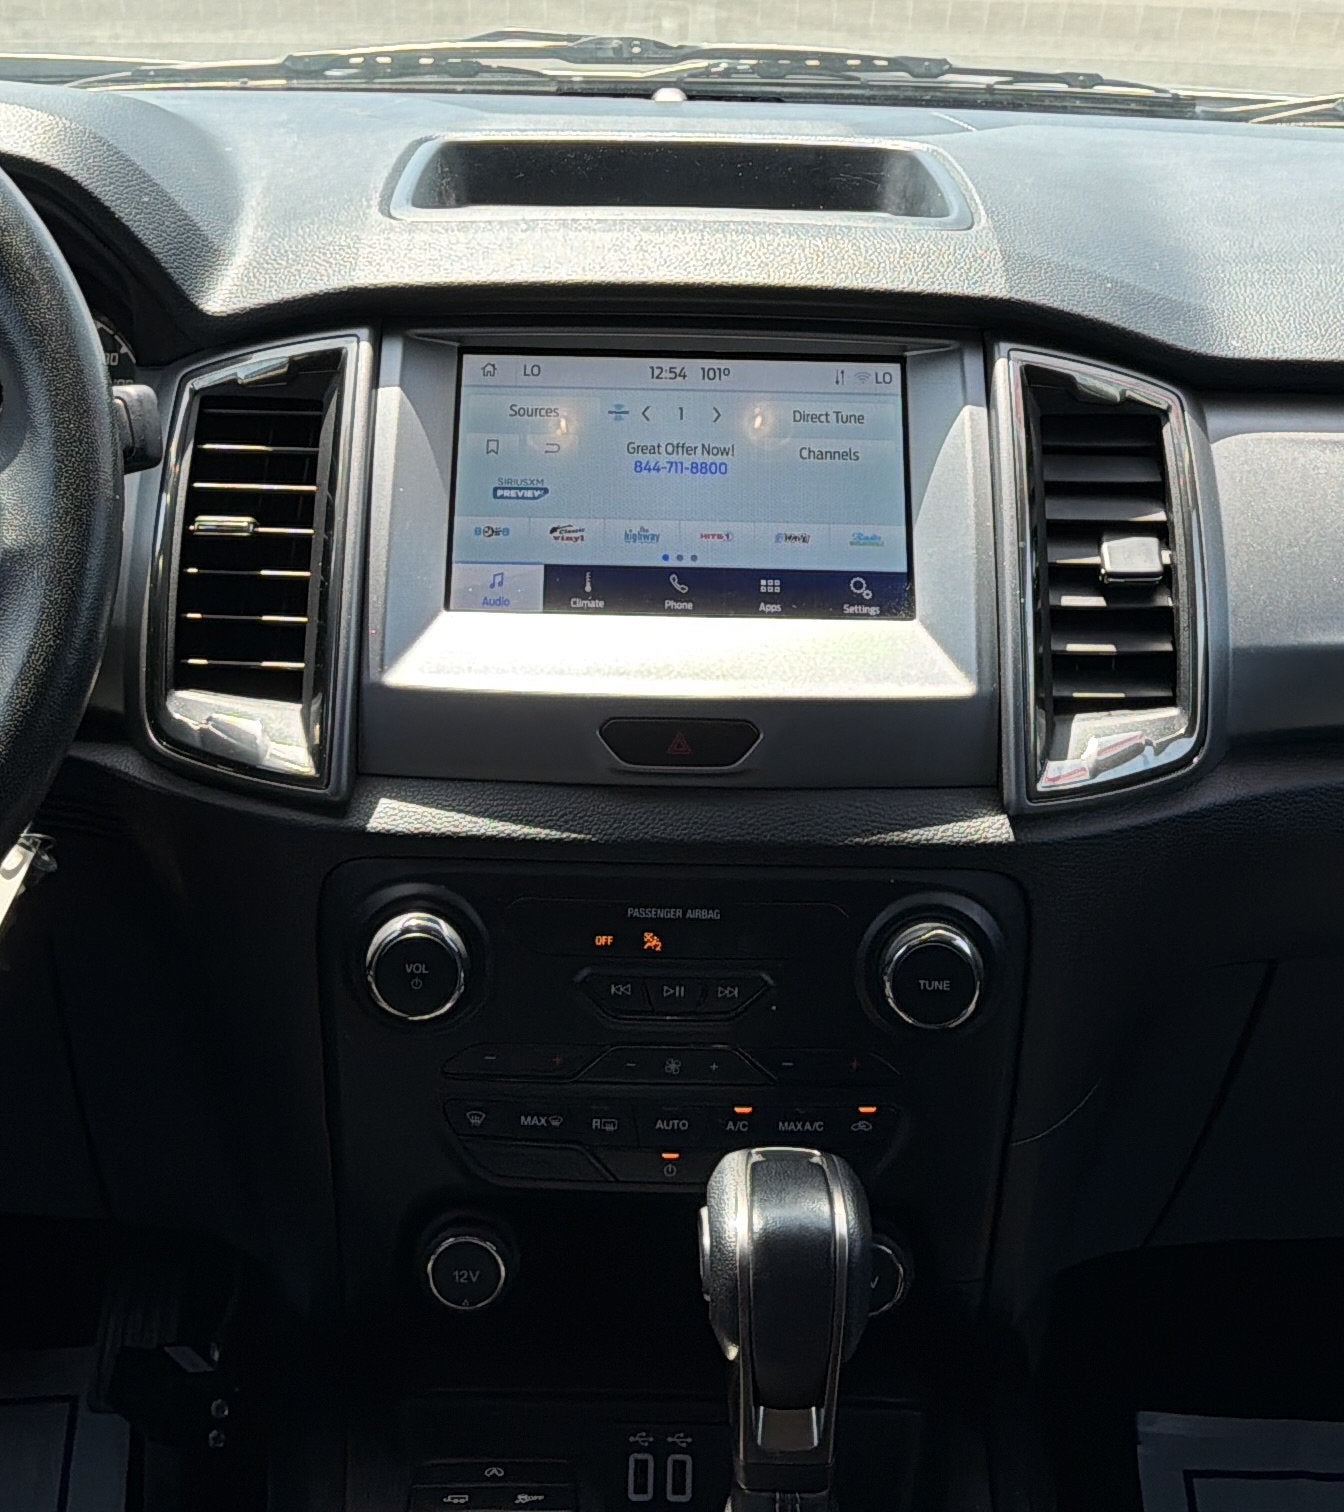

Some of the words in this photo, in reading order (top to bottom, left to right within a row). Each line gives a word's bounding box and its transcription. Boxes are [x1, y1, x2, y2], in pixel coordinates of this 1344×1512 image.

[523, 364, 541, 377] LO
[649, 366, 687, 381] 12:54
[874, 371, 893, 385] LO
[509, 403, 560, 418] Sources
[677, 406, 685, 421] 1
[793, 410, 830, 425] Direct
[832, 410, 865, 425] Tune
[626, 441, 662, 456] Great
[664, 442, 698, 457] Offer
[701, 443, 735, 457] Now!
[799, 446, 860, 462] Channels
[633, 461, 728, 476] 844-711-8800
[624, 528, 660, 544] highway
[483, 596, 510, 607] Audio
[570, 597, 605, 609] Climate
[664, 599, 693, 610] Phone
[759, 602, 782, 614] Apps
[843, 603, 880, 615] Settings
[626, 907, 682, 920] PASSENGER
[685, 908, 721, 921] AIRBAG
[594, 935, 614, 946] OFF
[405, 963, 429, 974] VOL
[918, 979, 951, 991] TUNE
[520, 1115, 547, 1127] MAX
[656, 1119, 689, 1131] AUTO
[725, 1120, 749, 1132] A/C
[778, 1120, 803, 1132] MAX
[803, 1120, 825, 1132] A/C
[452, 1269, 480, 1283] 12V
